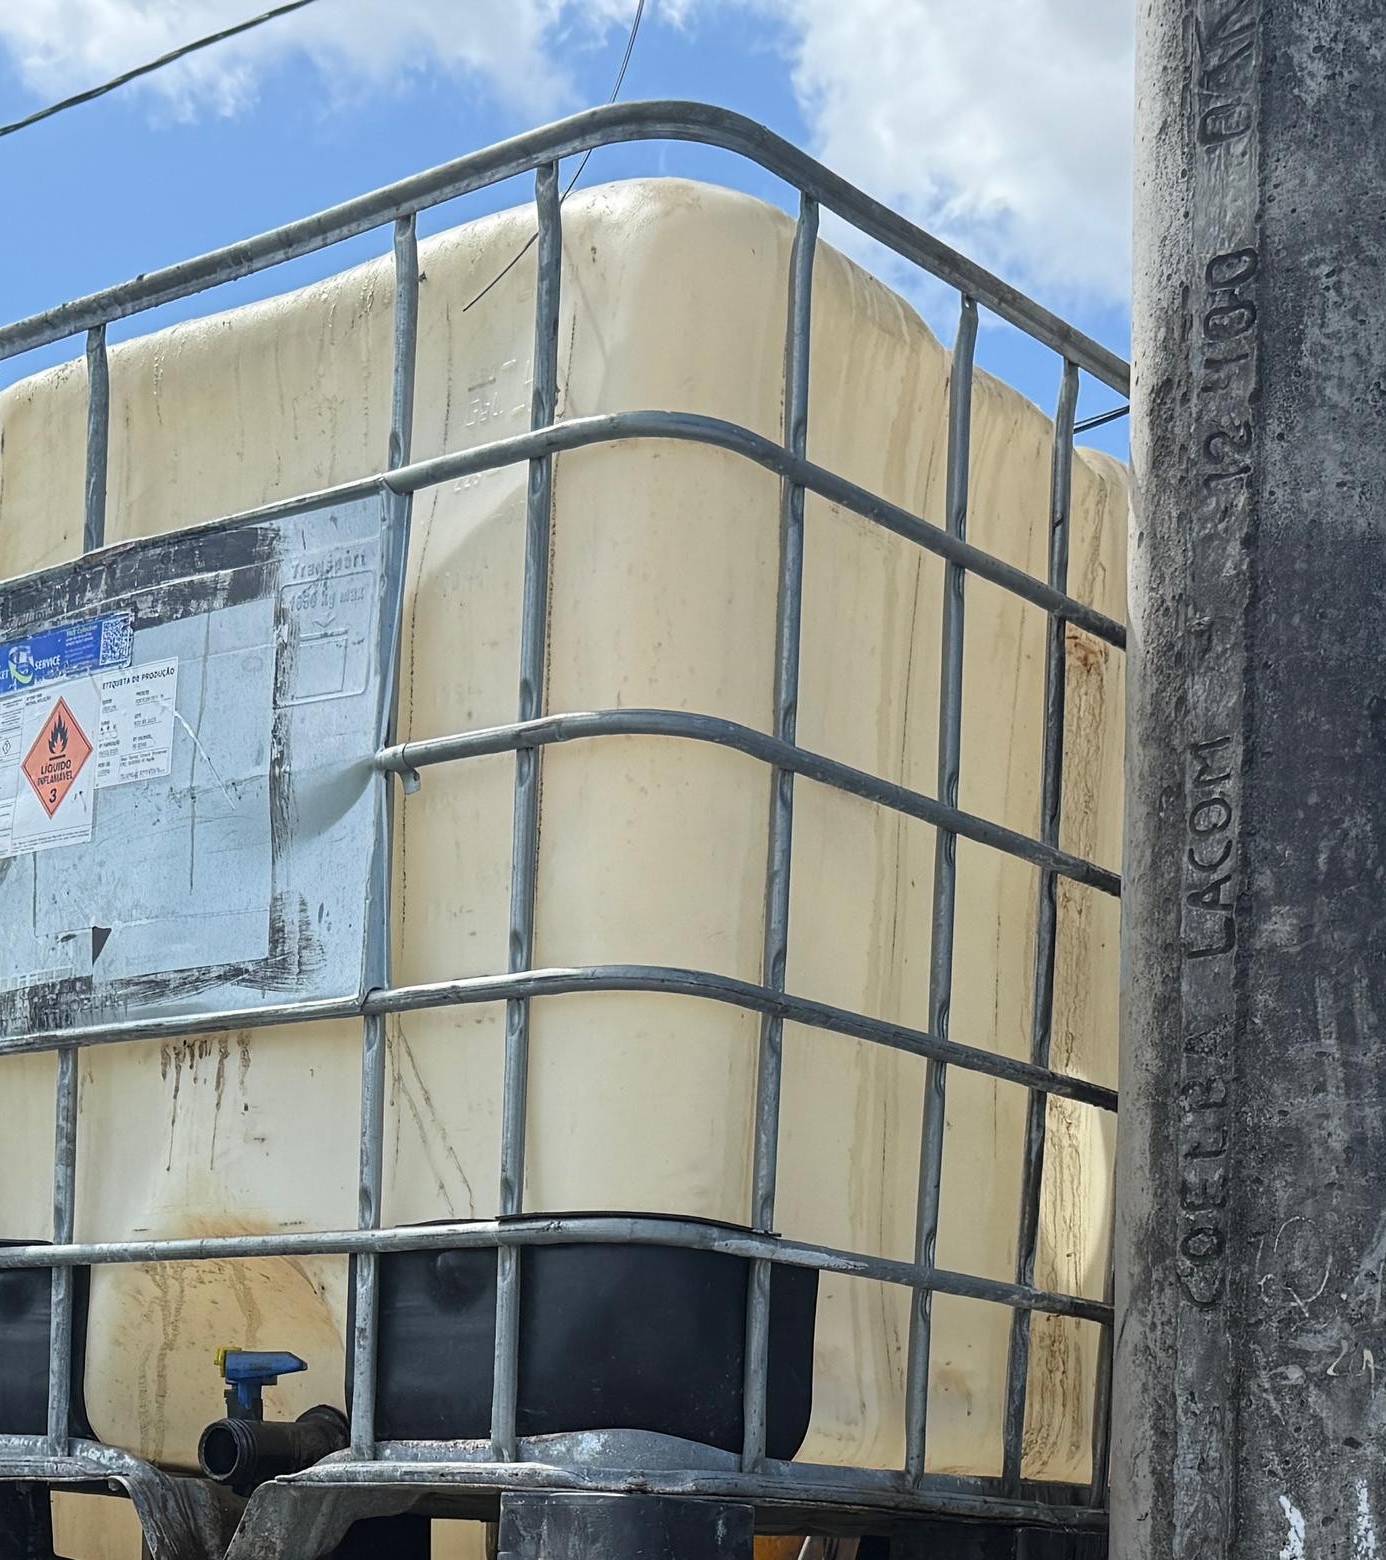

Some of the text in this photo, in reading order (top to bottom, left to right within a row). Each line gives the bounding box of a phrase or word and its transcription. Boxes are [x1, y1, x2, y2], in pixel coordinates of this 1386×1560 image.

[34, 655, 61, 671] SERVICE
[40, 759, 72, 775] LÍQUIDO
[37, 770, 73, 786] INFLAMÁVEL
[48, 788, 58, 804] 3
[1187, 735, 1234, 961] LACOM
[1176, 1027, 1233, 1311] COELBA
